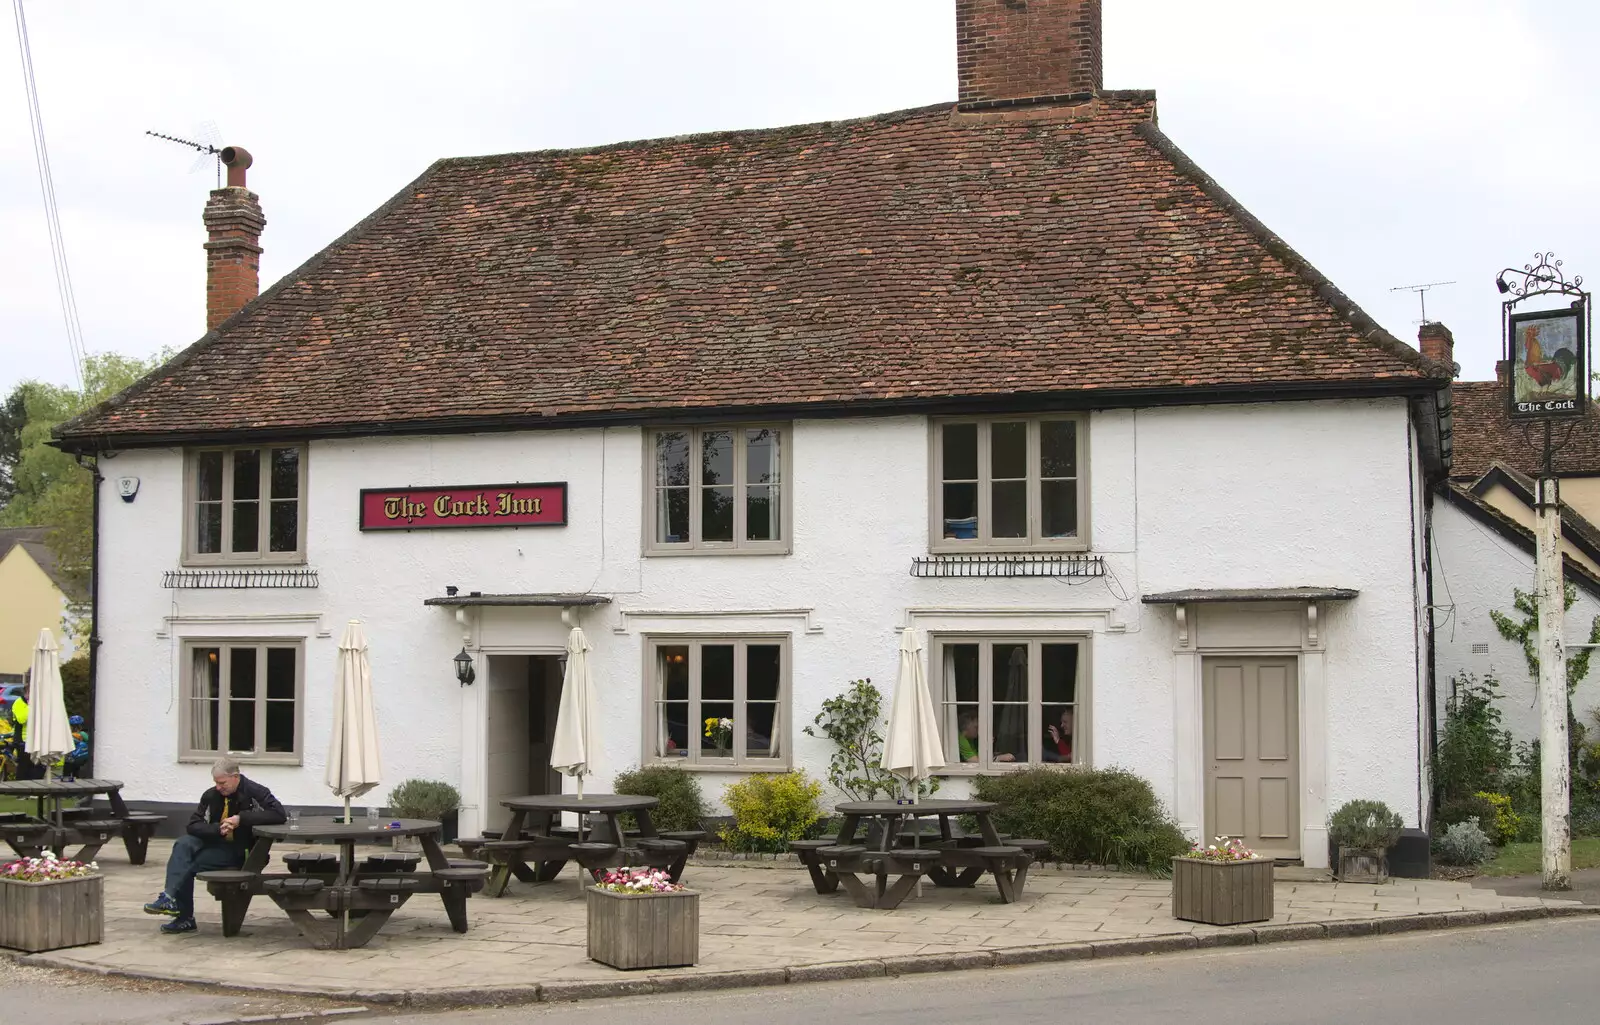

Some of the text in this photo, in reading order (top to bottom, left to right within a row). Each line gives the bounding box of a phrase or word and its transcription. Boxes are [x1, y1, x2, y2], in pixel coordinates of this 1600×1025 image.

[1517, 400, 1575, 412] The Cock
[384, 492, 542, 523] The Cock Inn
